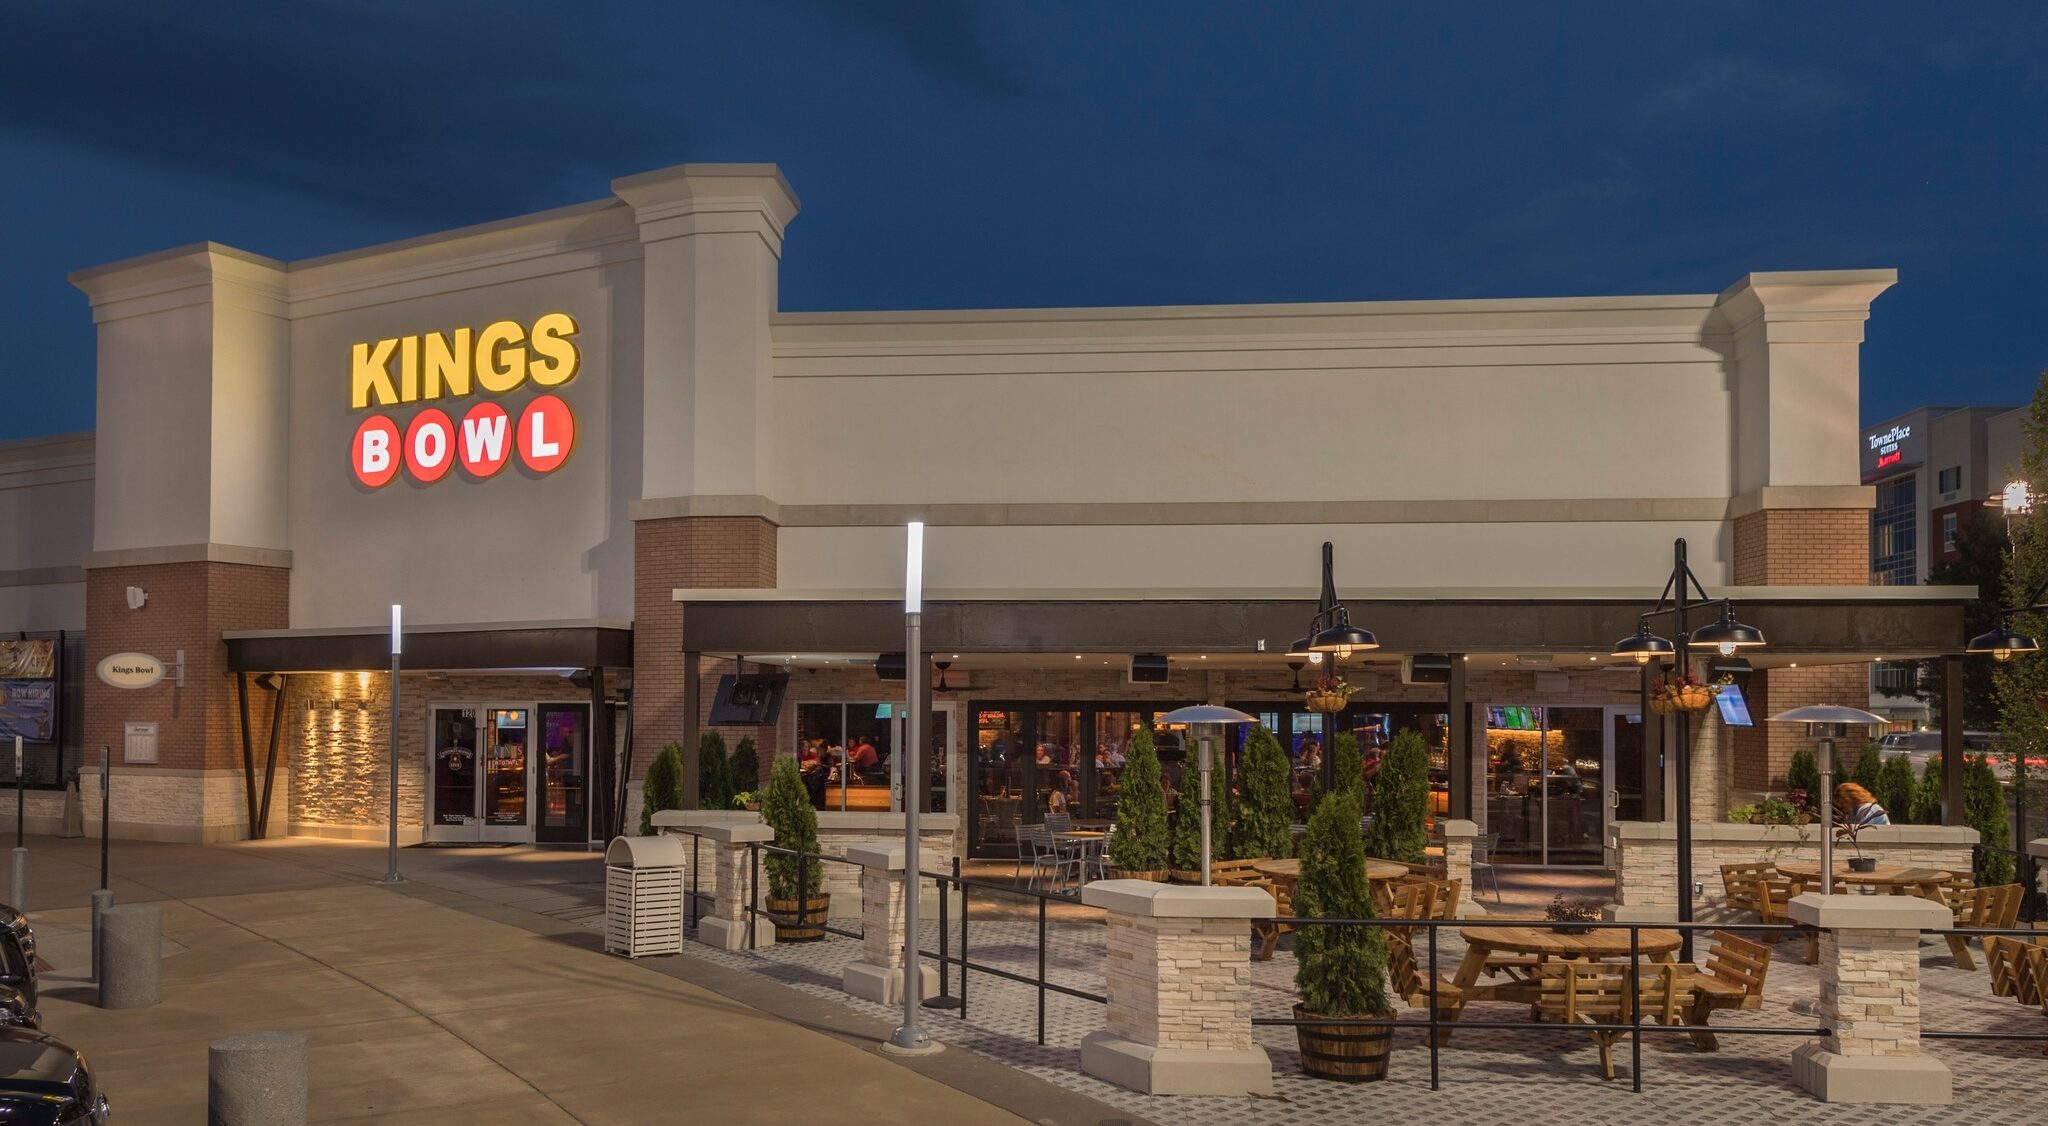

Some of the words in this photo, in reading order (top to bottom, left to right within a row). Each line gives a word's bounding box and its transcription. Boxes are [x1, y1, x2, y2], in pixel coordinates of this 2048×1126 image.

[351, 312, 580, 409] KINGS
[361, 410, 560, 475] BOWL
[1869, 426, 1910, 449] TownePlace
[1880, 442, 1898, 455] SUITES
[112, 666, 134, 674] Kings
[135, 666, 154, 674] Bowl
